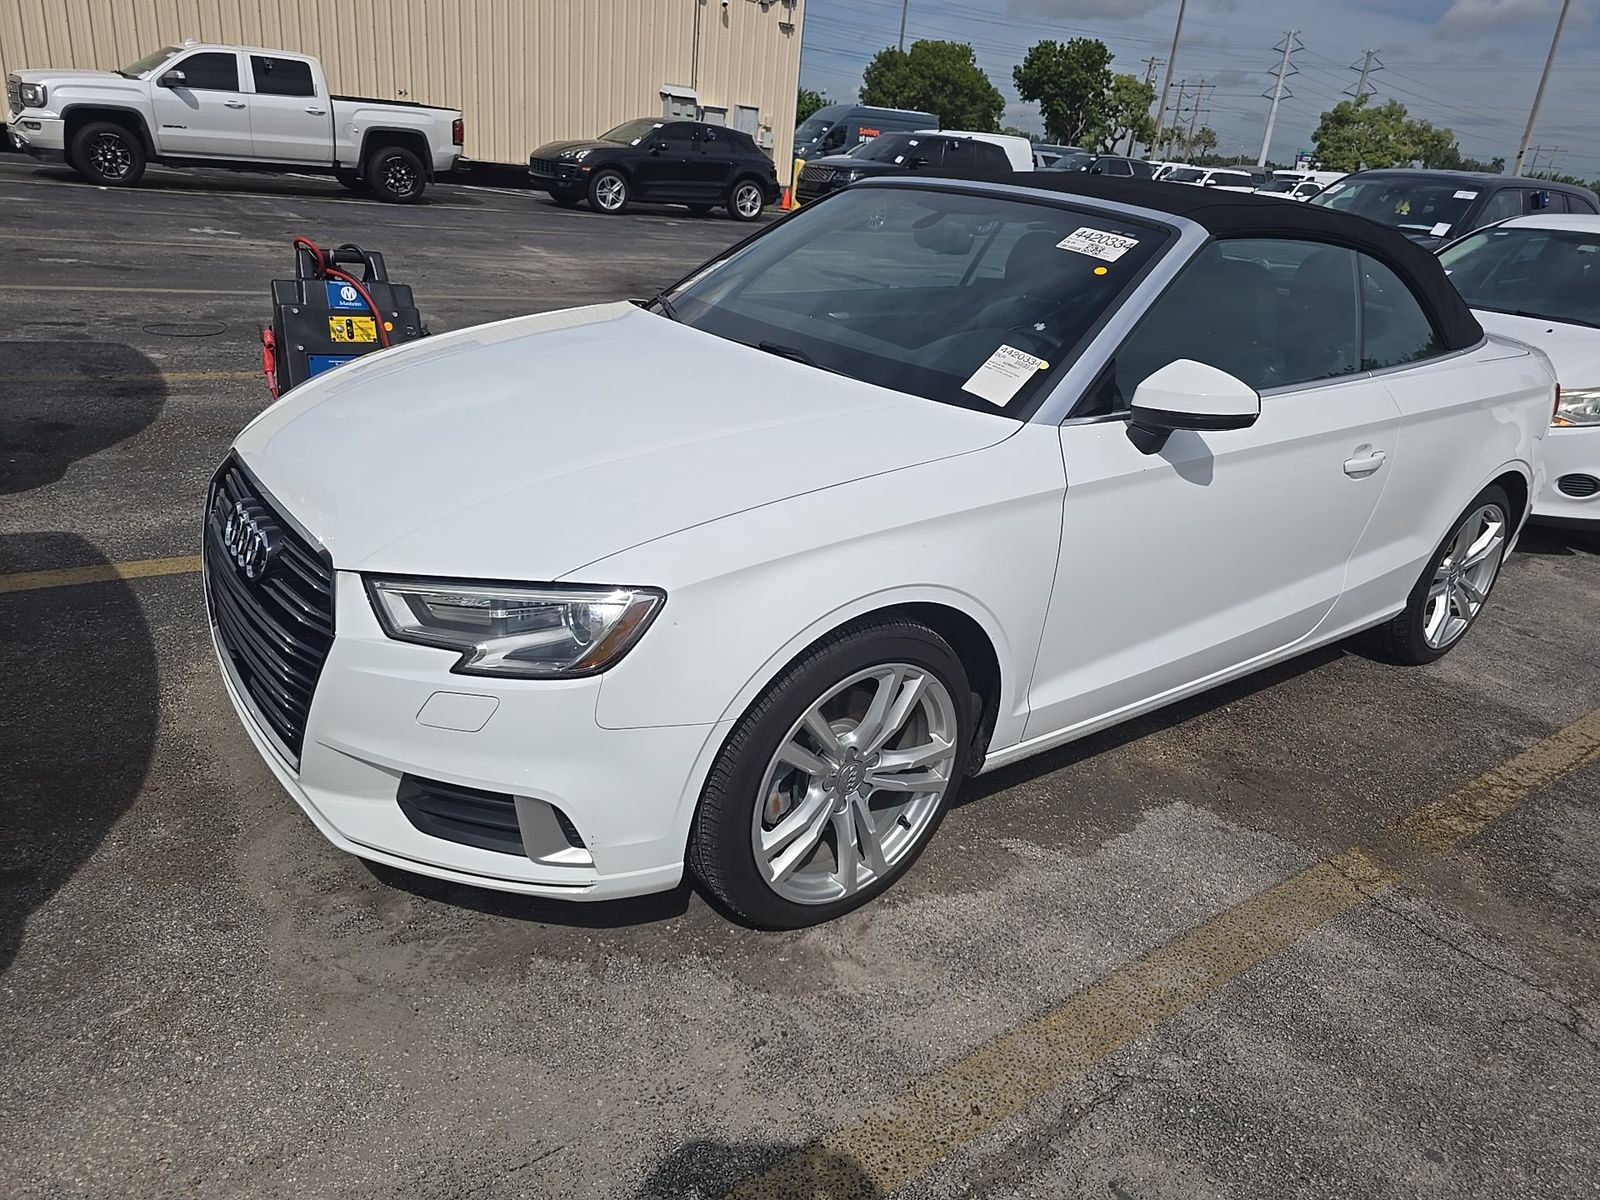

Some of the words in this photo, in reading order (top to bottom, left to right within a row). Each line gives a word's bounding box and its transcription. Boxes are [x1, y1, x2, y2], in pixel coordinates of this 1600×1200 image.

[859, 127, 880, 137] Savings
[1075, 230, 1134, 250] 4420334
[1000, 347, 1042, 368] 4420334
